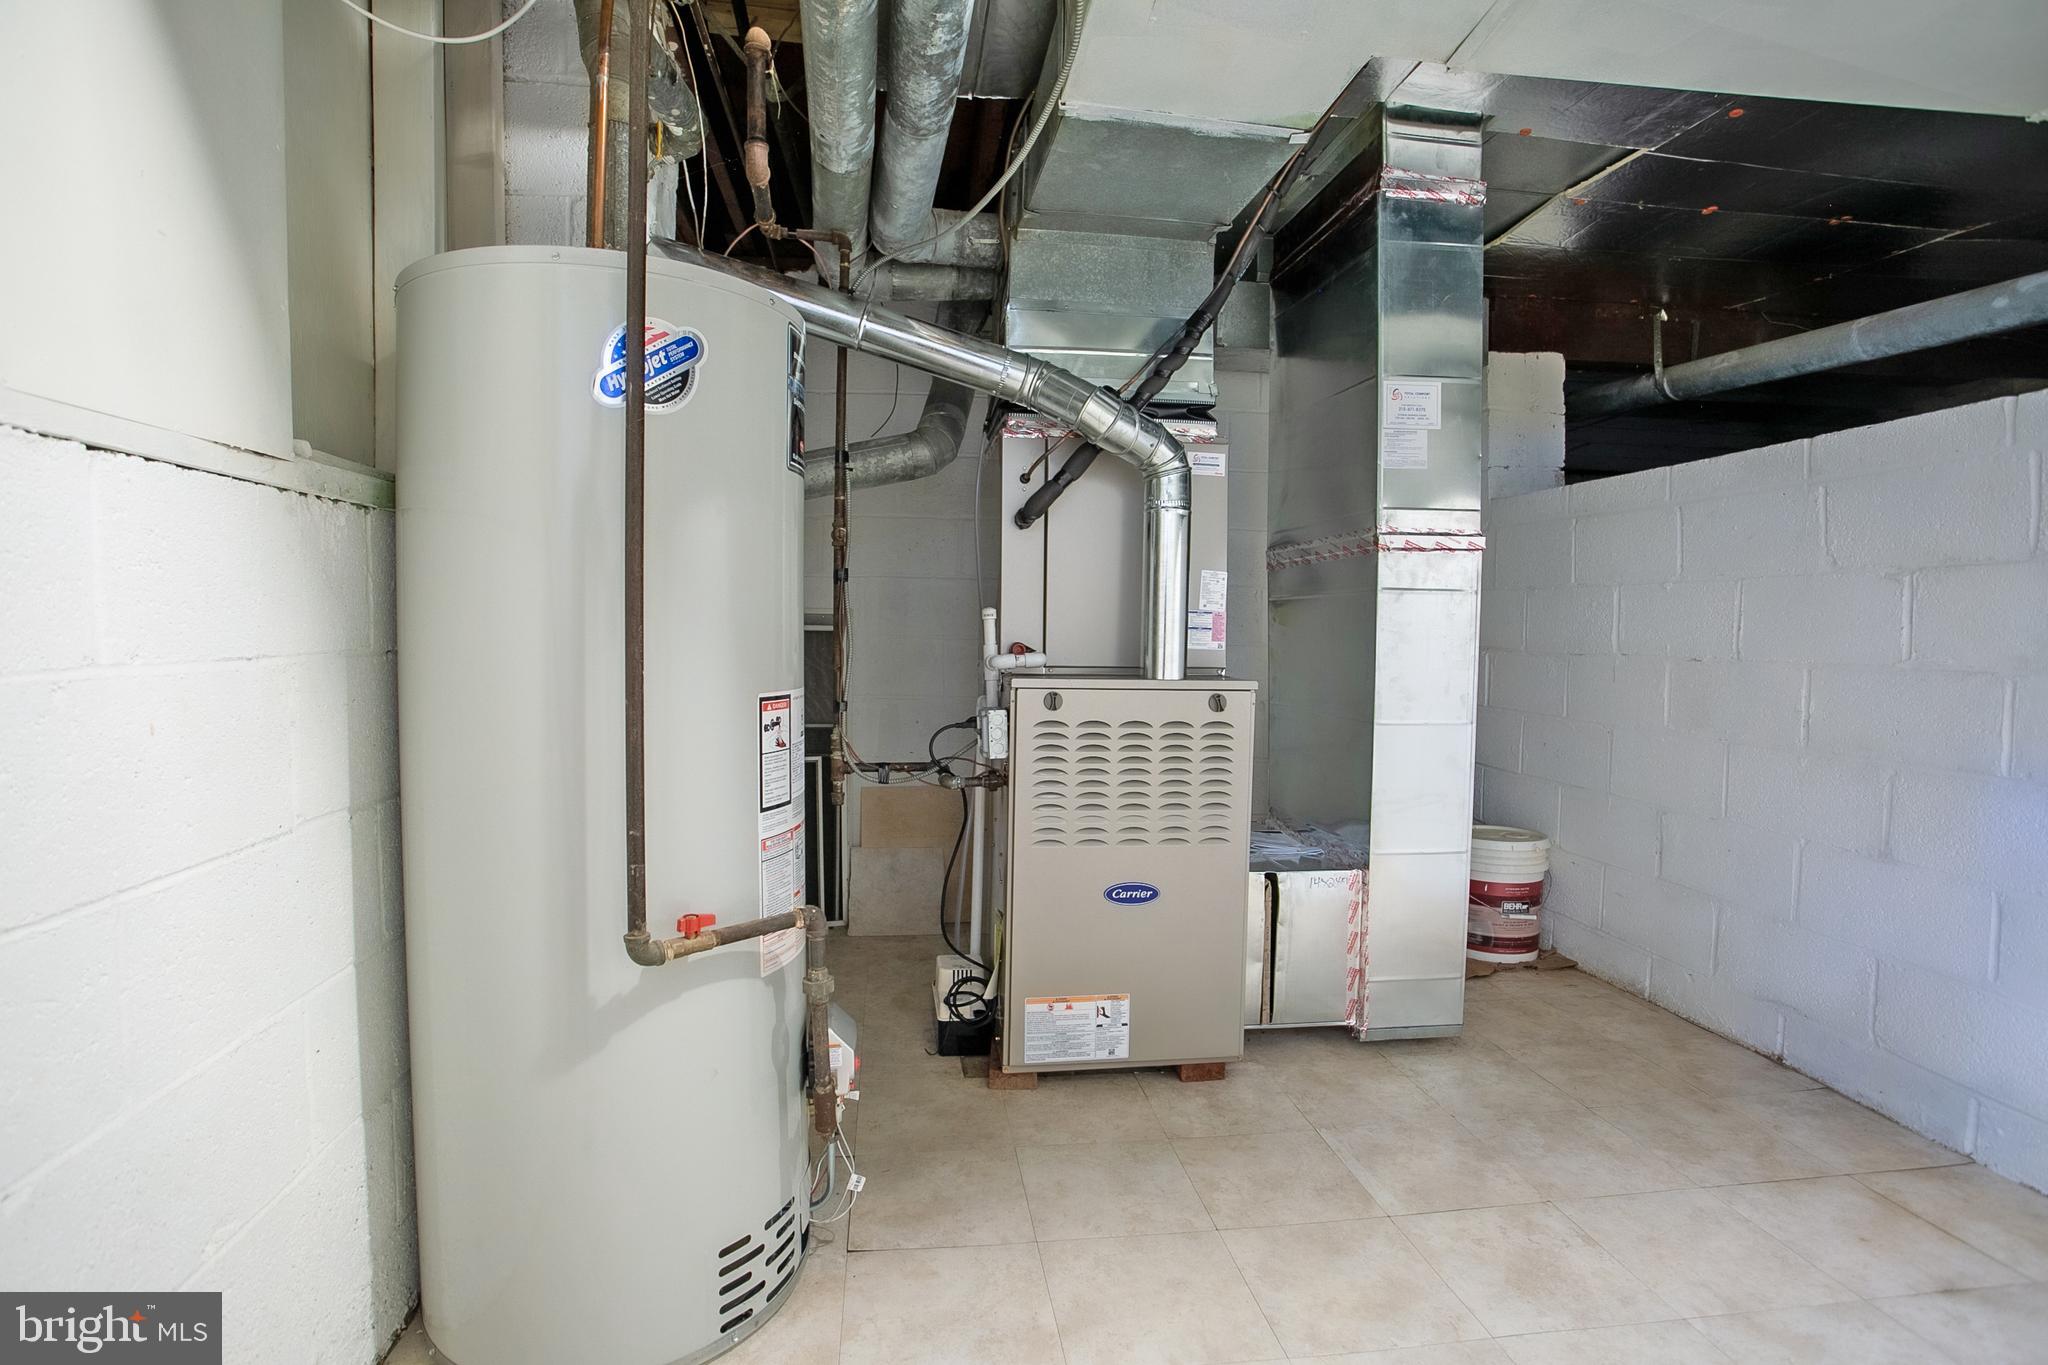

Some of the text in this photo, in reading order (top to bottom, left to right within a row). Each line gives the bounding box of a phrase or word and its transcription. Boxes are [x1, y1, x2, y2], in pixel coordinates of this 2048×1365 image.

[667, 341, 695, 357] PERFORMANCE
[669, 351, 685, 363] SYSTEM
[605, 349, 668, 392] Hyjet
[1112, 888, 1153, 899] Carrier
[1503, 902, 1522, 910] BEHR
